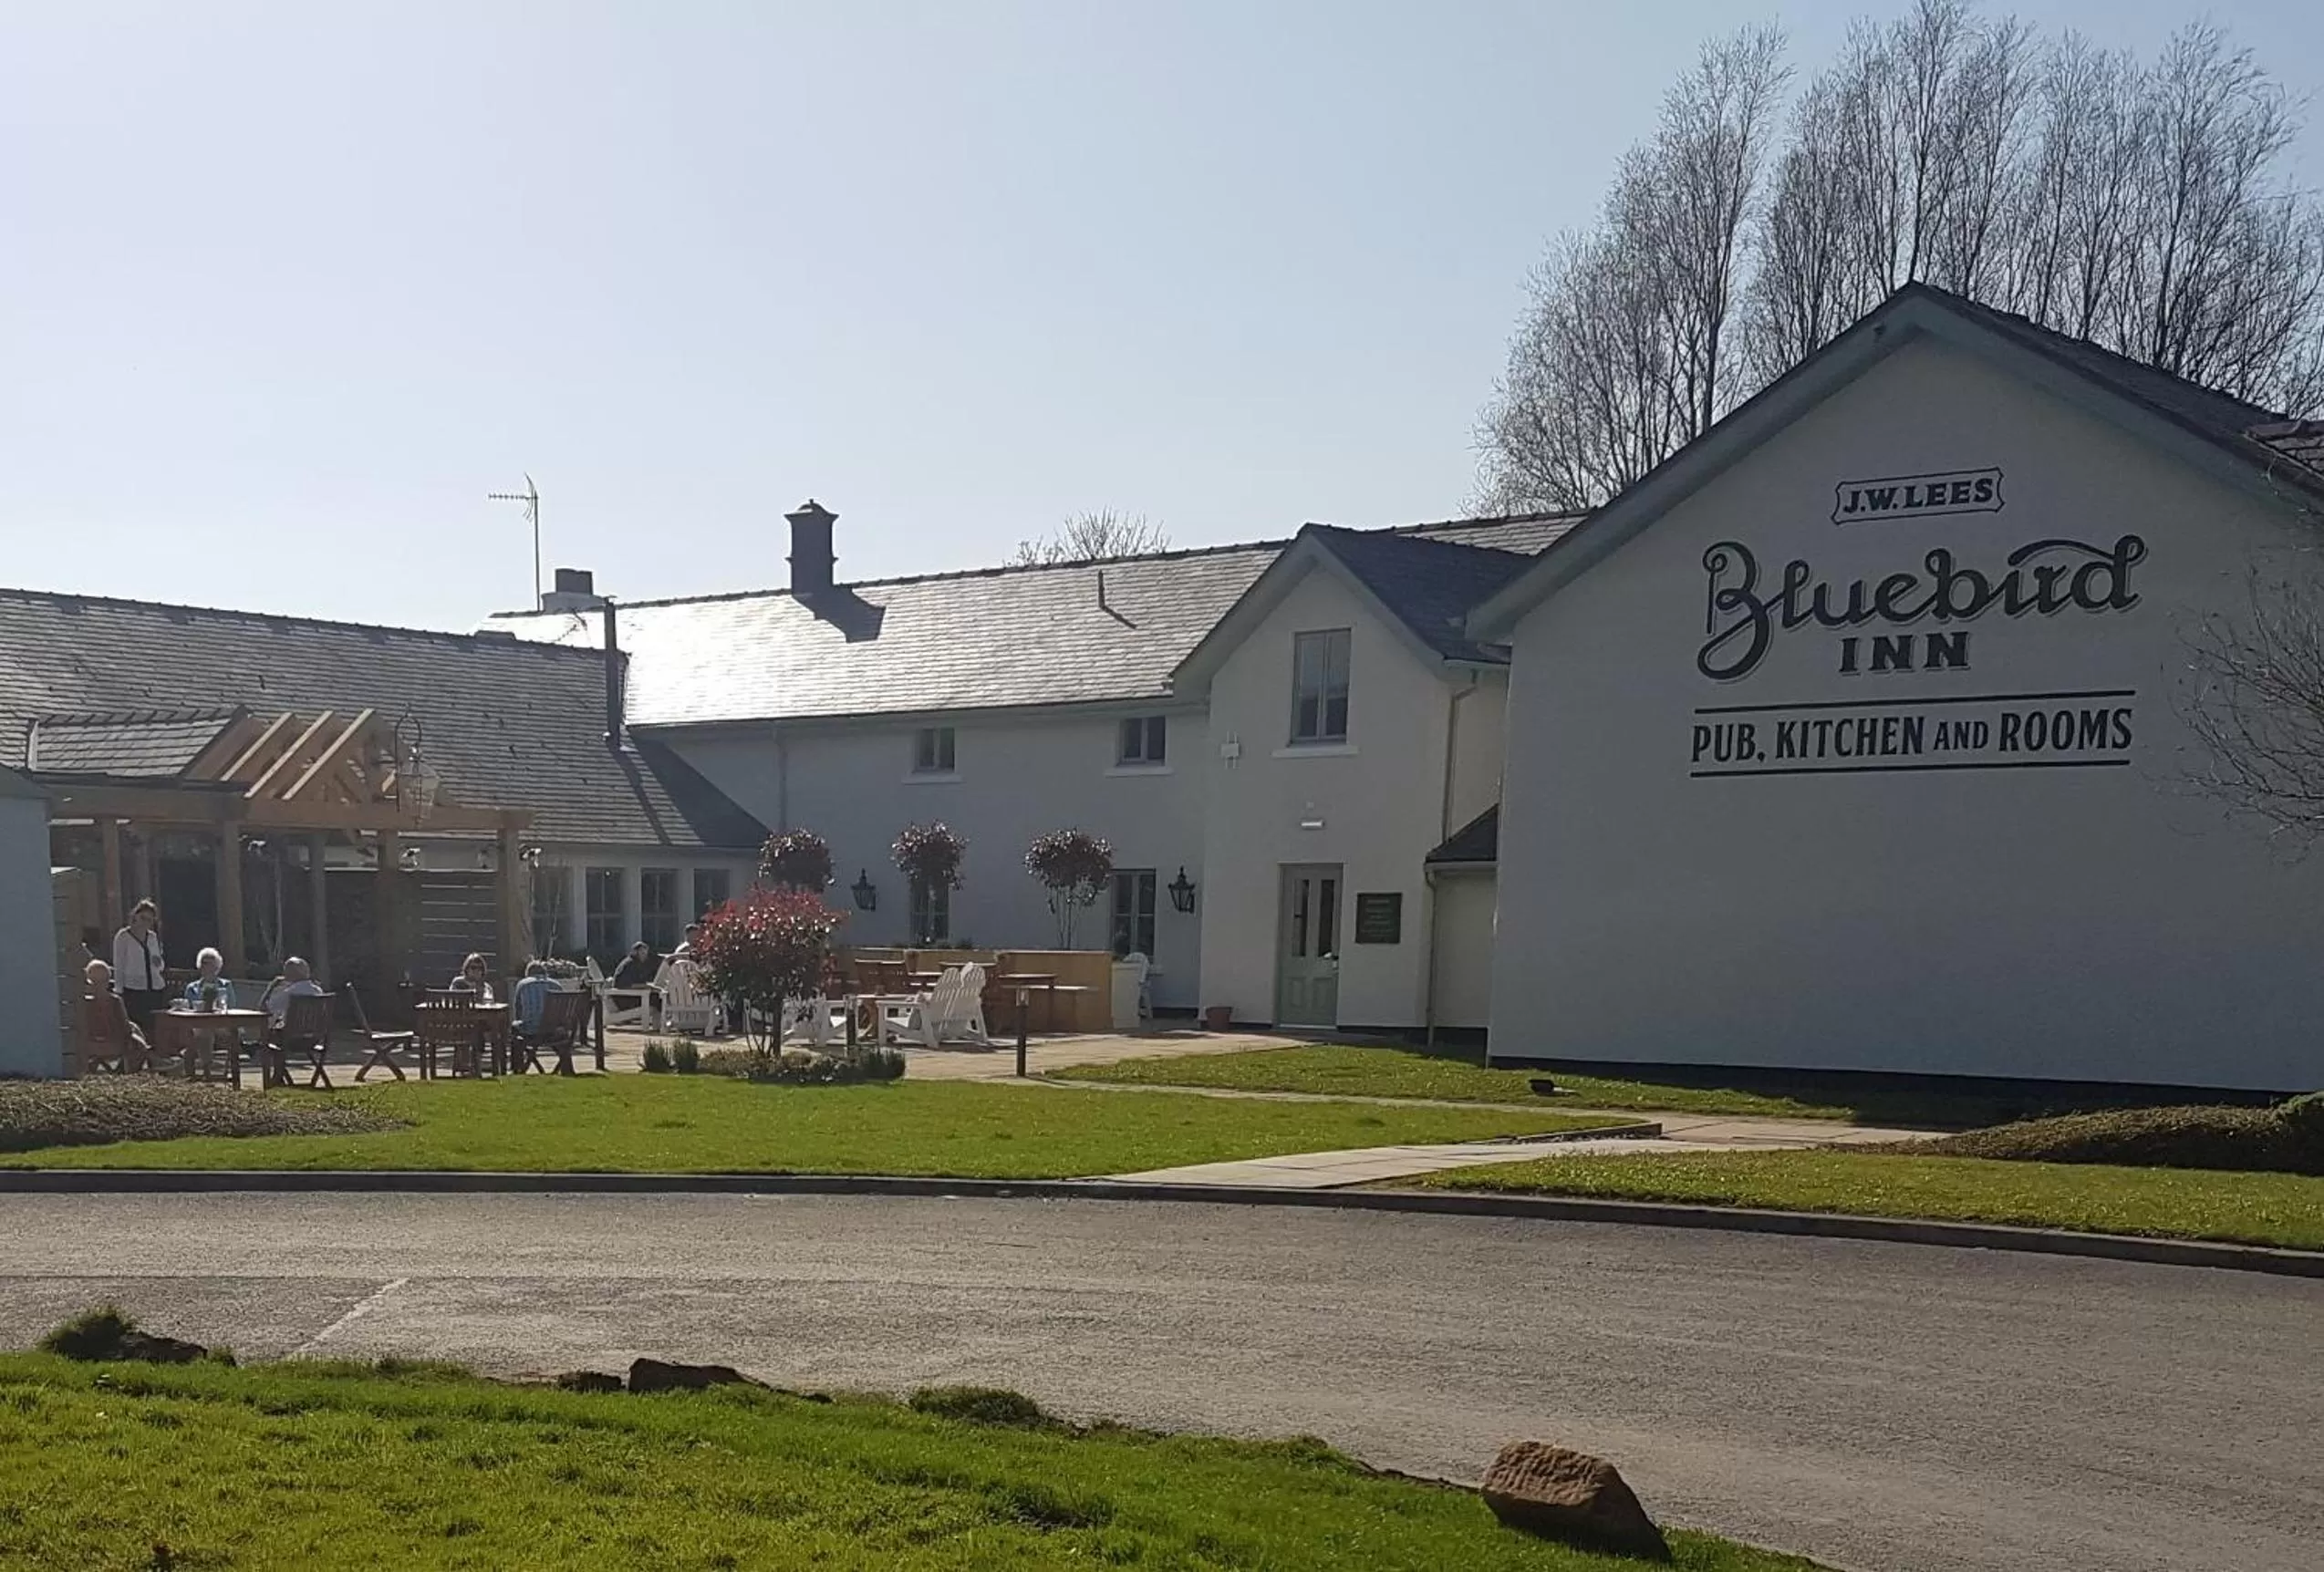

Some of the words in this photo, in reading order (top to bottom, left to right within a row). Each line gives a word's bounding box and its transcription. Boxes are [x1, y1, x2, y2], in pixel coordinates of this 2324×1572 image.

[1697, 534, 2146, 680] Bluebird
[1839, 631, 1970, 672] INN
[1776, 716, 1925, 759] KITCHEN
[1934, 719, 1988, 750] AND
[1998, 708, 2132, 752] ROOMS
